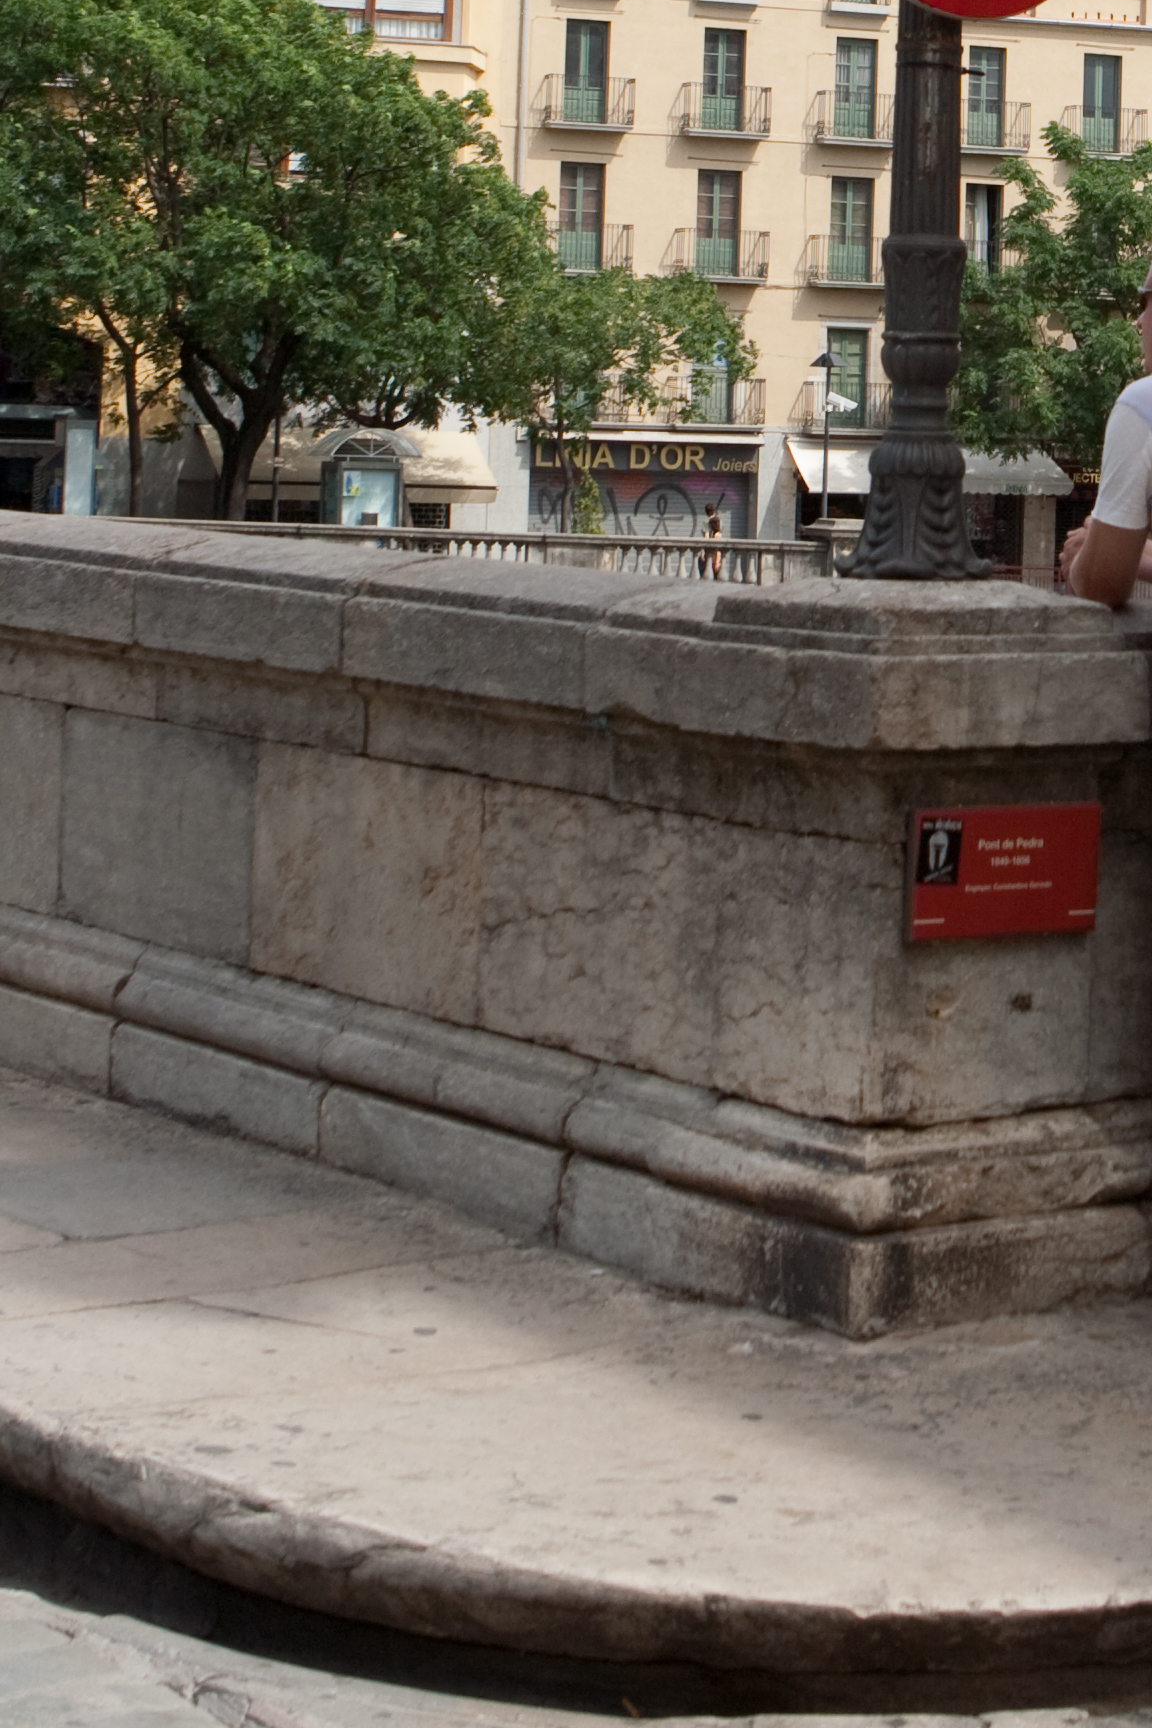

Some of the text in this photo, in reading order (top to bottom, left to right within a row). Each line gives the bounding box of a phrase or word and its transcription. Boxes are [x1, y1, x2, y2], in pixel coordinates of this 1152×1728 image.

[629, 443, 706, 471] D'OR
[712, 458, 758, 472] Joiers
[978, 837, 1044, 851] Pont de Pedra
